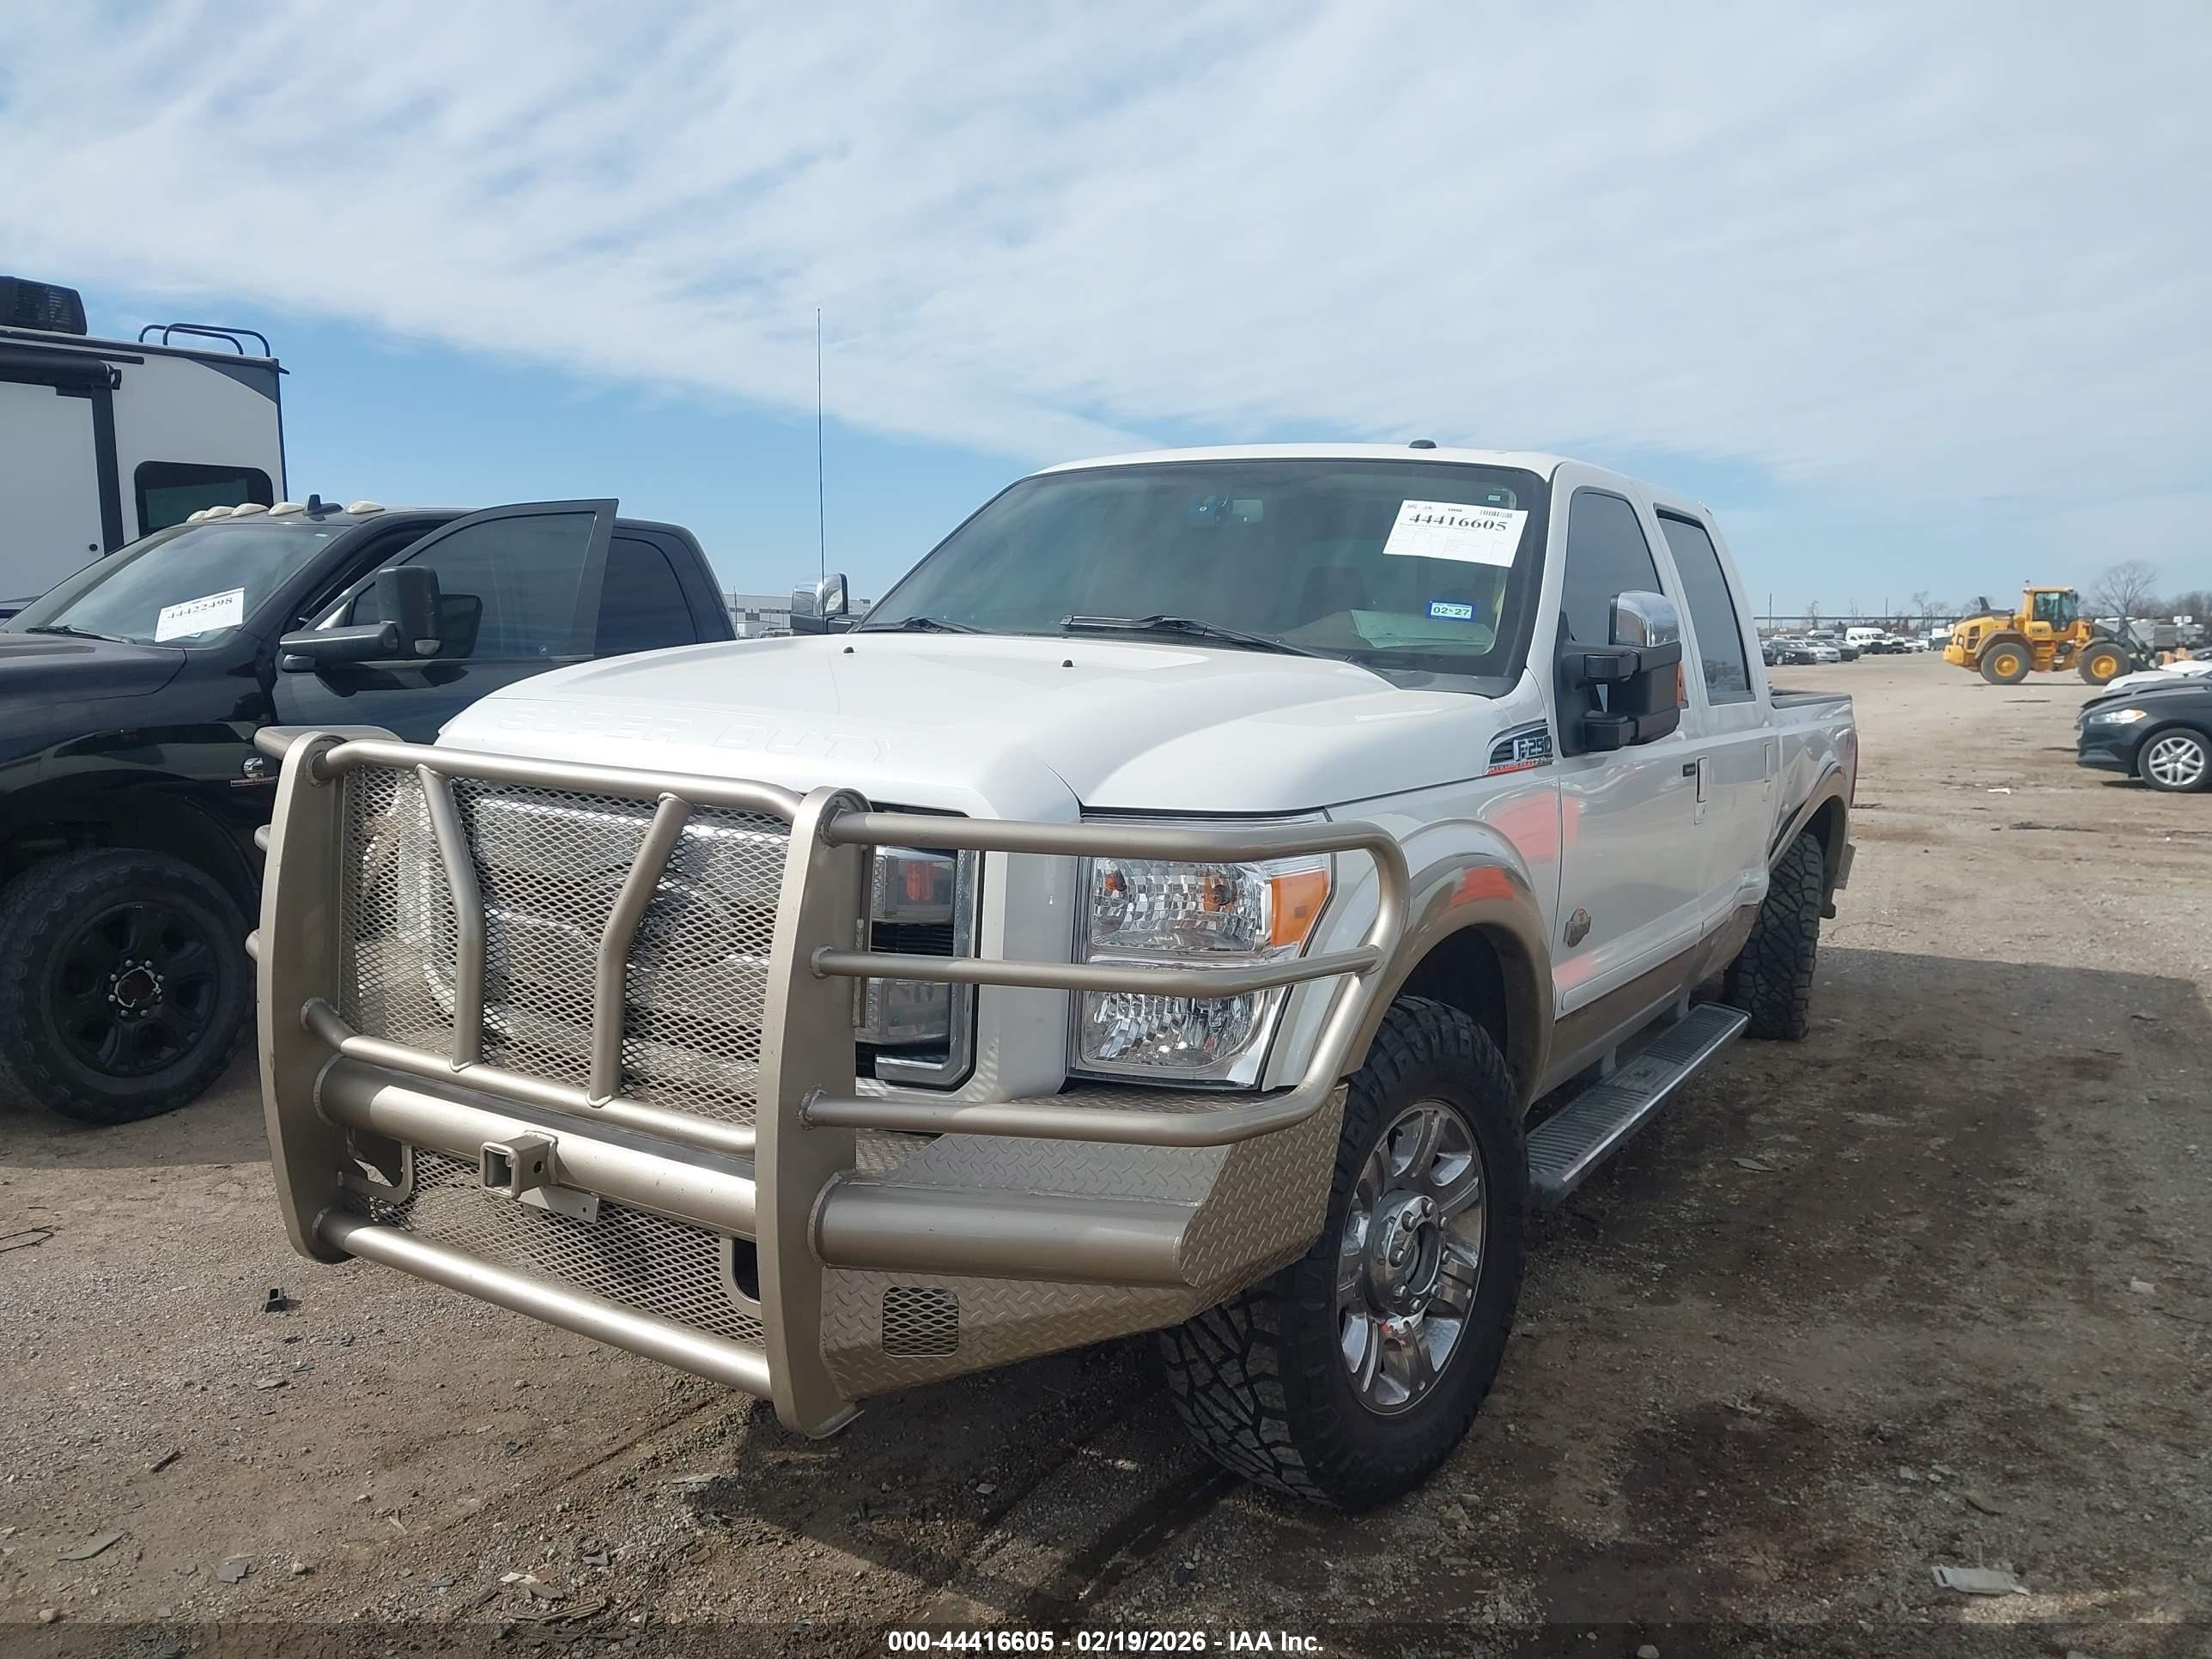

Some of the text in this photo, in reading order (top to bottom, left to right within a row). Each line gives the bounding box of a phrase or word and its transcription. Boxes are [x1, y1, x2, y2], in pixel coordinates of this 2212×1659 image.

[1409, 514, 1508, 532] 44416605
[167, 597, 233, 619] 44422498
[497, 706, 693, 744] SUPER
